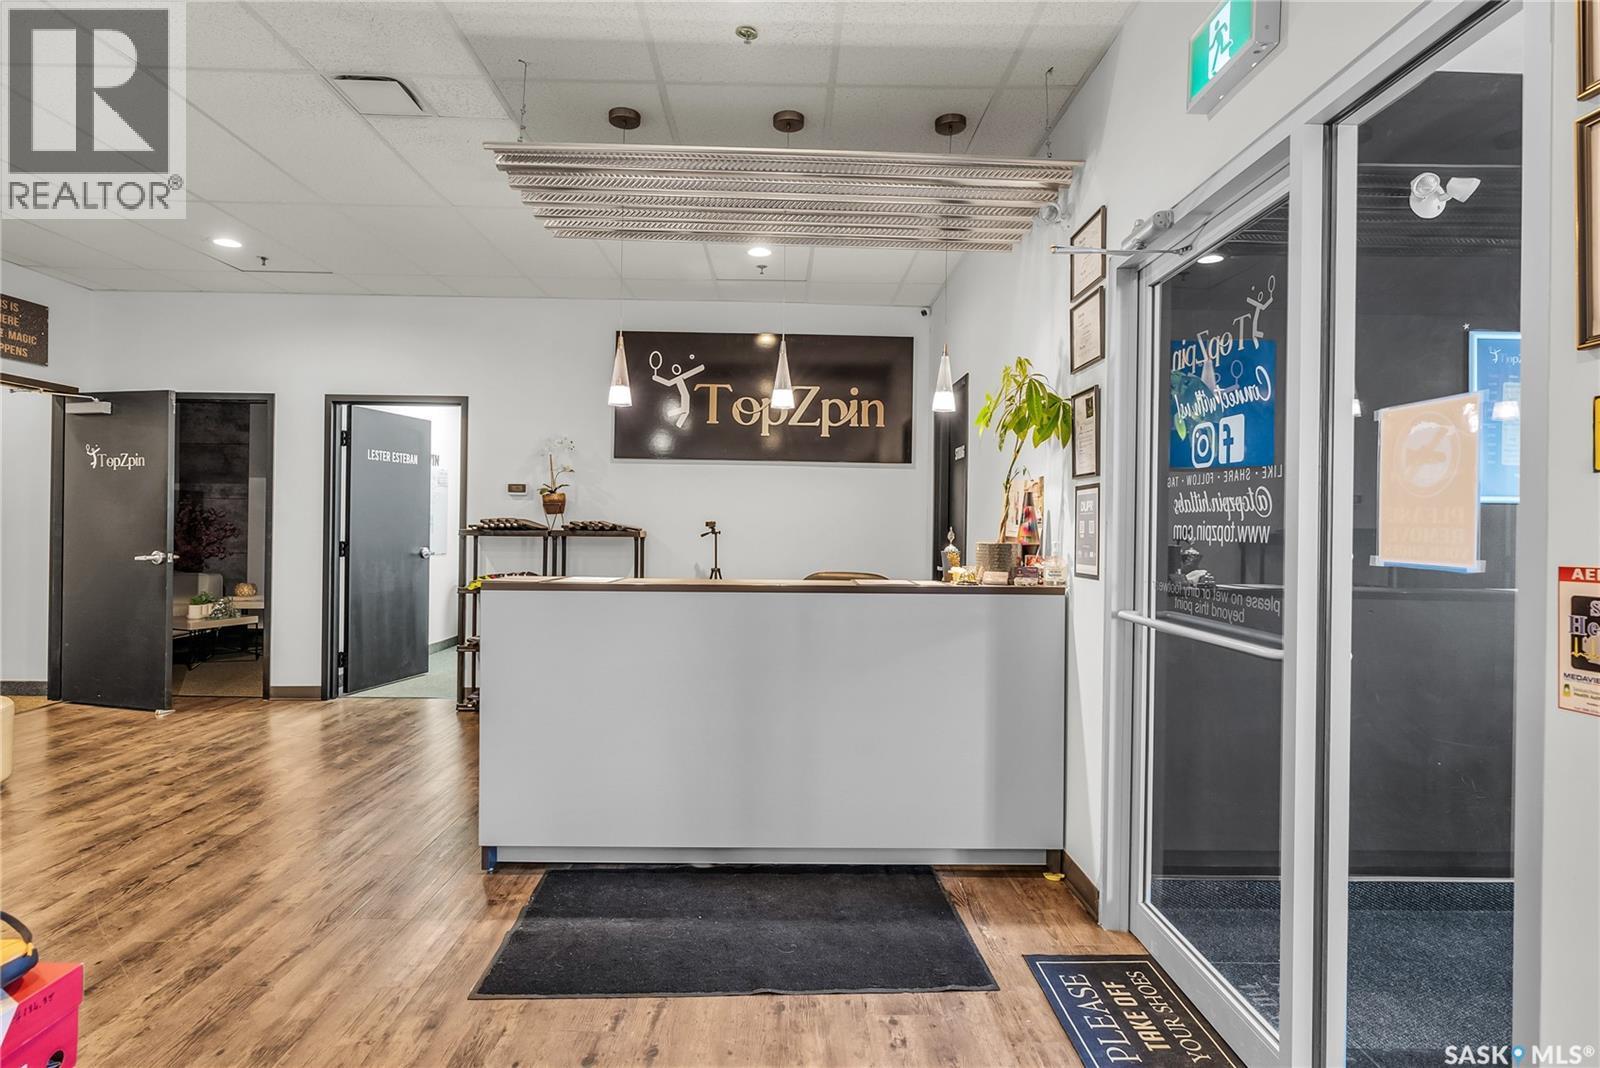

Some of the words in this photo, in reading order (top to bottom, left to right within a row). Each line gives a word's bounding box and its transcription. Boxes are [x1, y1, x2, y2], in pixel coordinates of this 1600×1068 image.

[10, 301, 20, 313] IS
[8, 330, 37, 345] MAGIC
[0, 342, 28, 358] PPENS
[694, 383, 886, 438] TopZpin
[97, 453, 146, 471] TopZpin
[367, 449, 391, 463] LESTER
[392, 452, 418, 465] ESTEBAN
[1568, 614, 1600, 636] He
[1102, 980, 1139, 1007] OFF
[1126, 970, 1175, 1014] SHOES
[1059, 973, 1143, 1064] PLEASE
[1123, 1010, 1172, 1052] TAKE
[1165, 1016, 1212, 1064] YOUR
